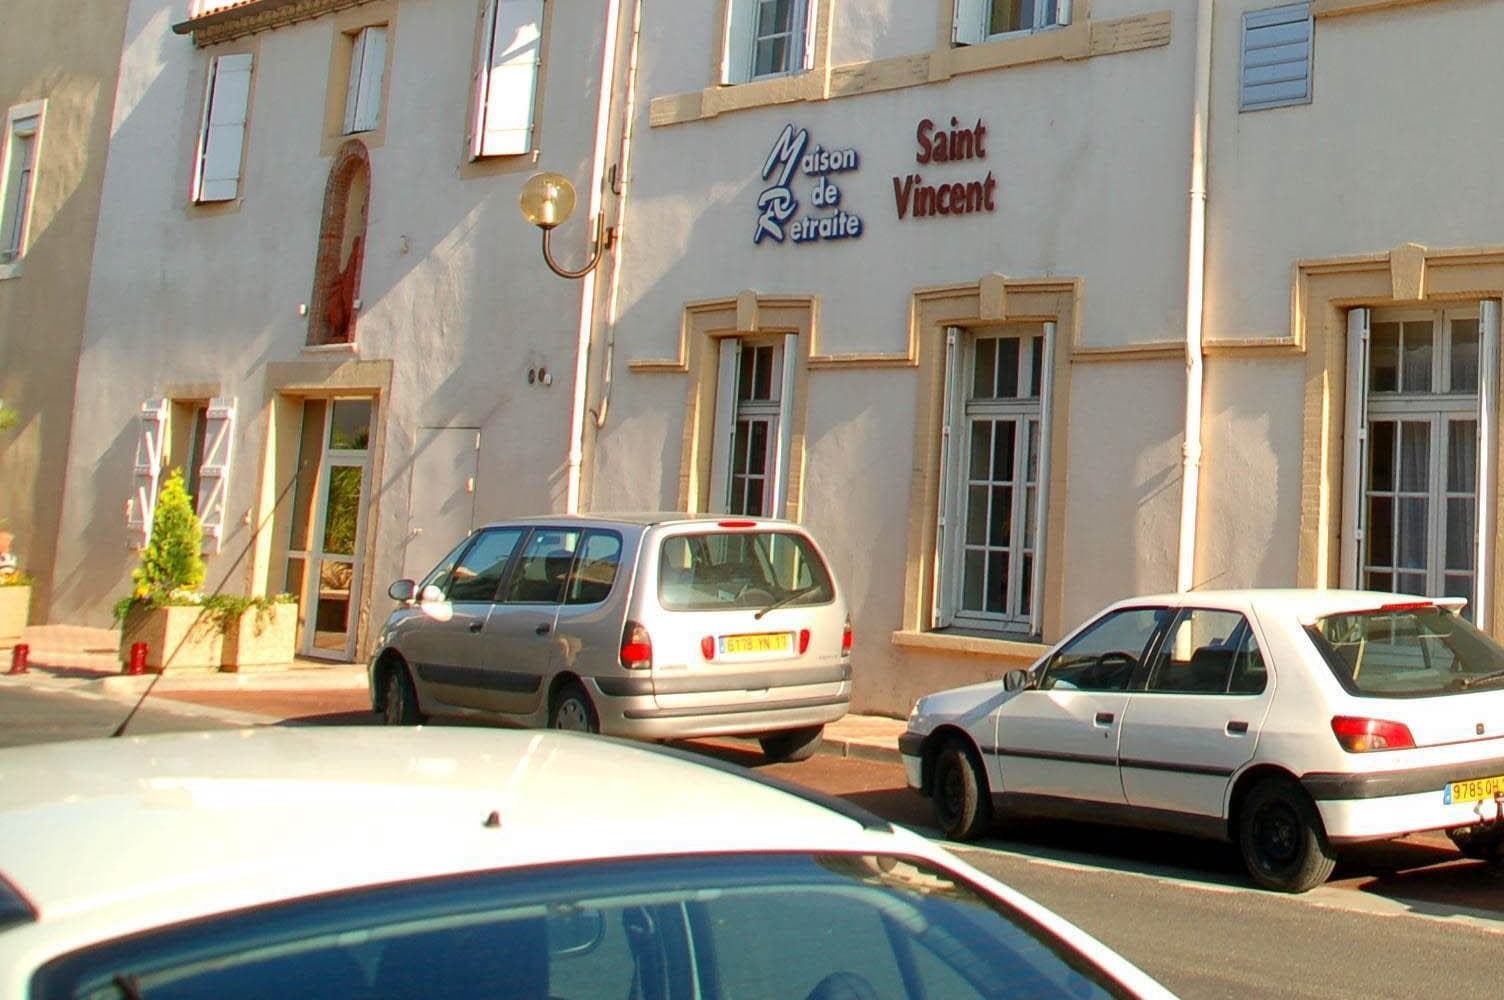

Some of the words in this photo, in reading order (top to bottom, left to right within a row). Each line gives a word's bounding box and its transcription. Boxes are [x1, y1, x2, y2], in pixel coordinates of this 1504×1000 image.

[761, 124, 860, 187] Maison
[915, 116, 986, 164] Saint
[753, 185, 863, 244] Retraite
[811, 176, 841, 208] de
[893, 170, 996, 220] Vincent
[1453, 780, 1484, 800] 9785
